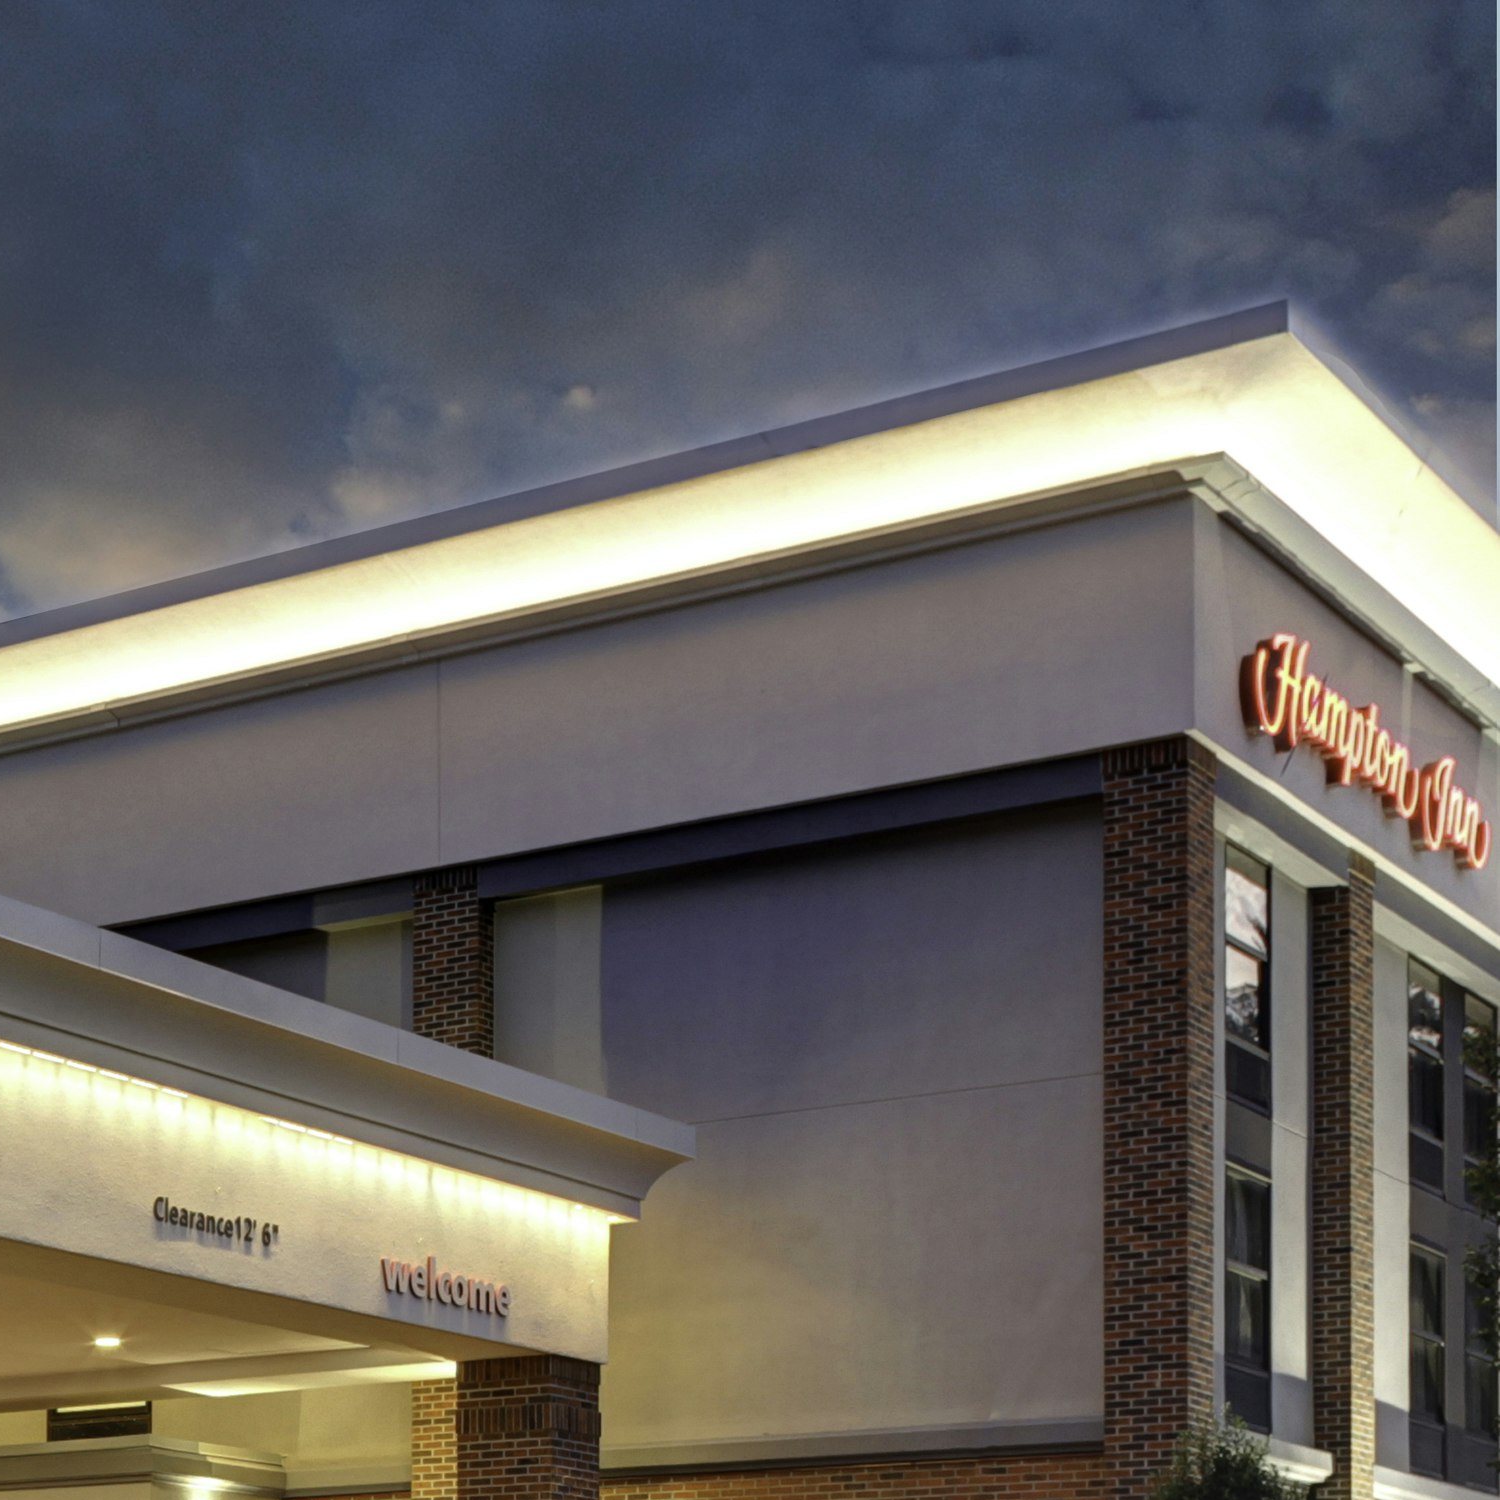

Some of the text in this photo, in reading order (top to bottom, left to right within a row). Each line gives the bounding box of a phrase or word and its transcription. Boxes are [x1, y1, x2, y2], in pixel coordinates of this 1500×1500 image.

[1239, 633, 1491, 869] Hampton Inn
[380, 1255, 512, 1318] welcome
